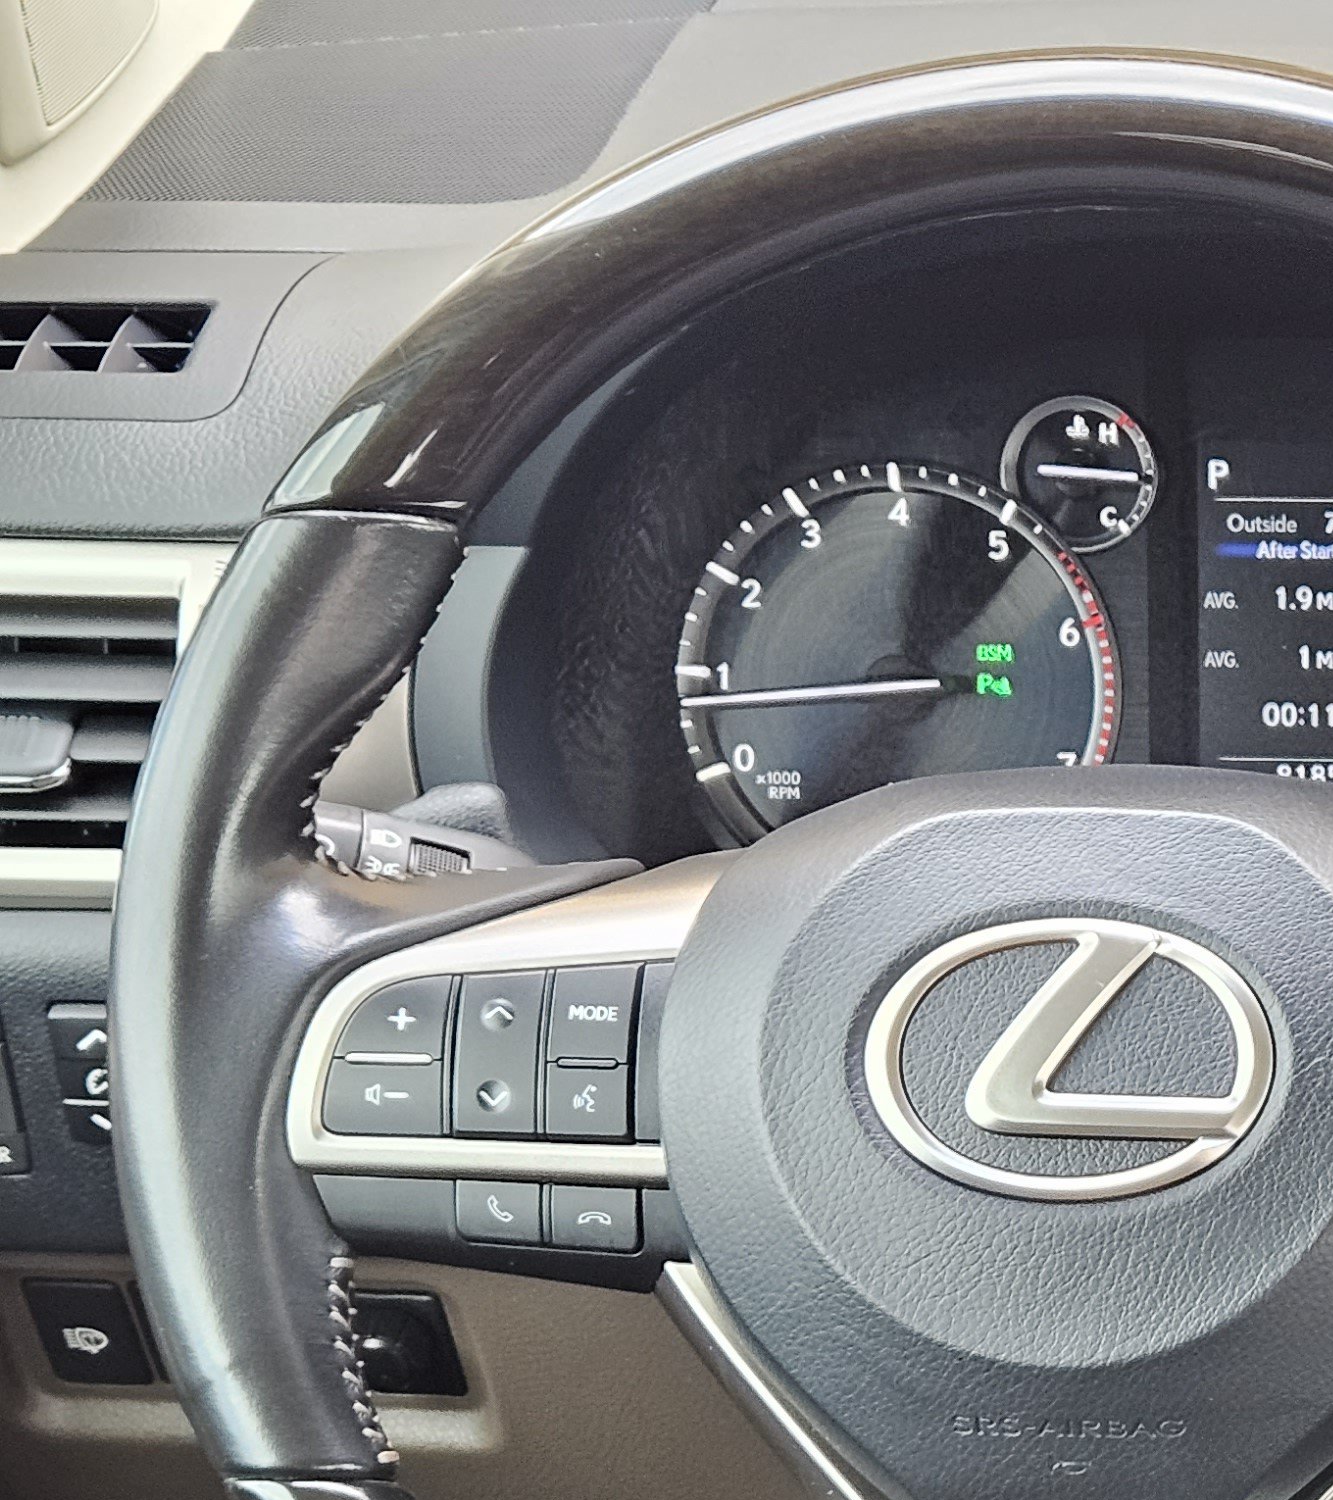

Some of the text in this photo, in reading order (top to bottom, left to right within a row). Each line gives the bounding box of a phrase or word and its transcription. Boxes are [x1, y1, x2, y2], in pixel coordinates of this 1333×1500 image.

[1098, 422, 1119, 445] H
[1207, 459, 1230, 491] P
[888, 499, 910, 527] 4
[1100, 506, 1118, 528] C
[1226, 512, 1298, 534] Outside
[800, 520, 822, 549] 3
[988, 531, 1010, 561] 5
[1255, 540, 1299, 561] After
[739, 578, 763, 609] 2
[1203, 591, 1239, 610] AVG.
[1275, 585, 1313, 612] 1.9
[1058, 619, 1081, 648] 6
[1204, 651, 1240, 670] AVG.
[1299, 645, 1310, 671] 1
[716, 663, 732, 690] 1
[733, 743, 755, 773] 0
[769, 785, 801, 800] RPM
[568, 1004, 619, 1023] MODE
